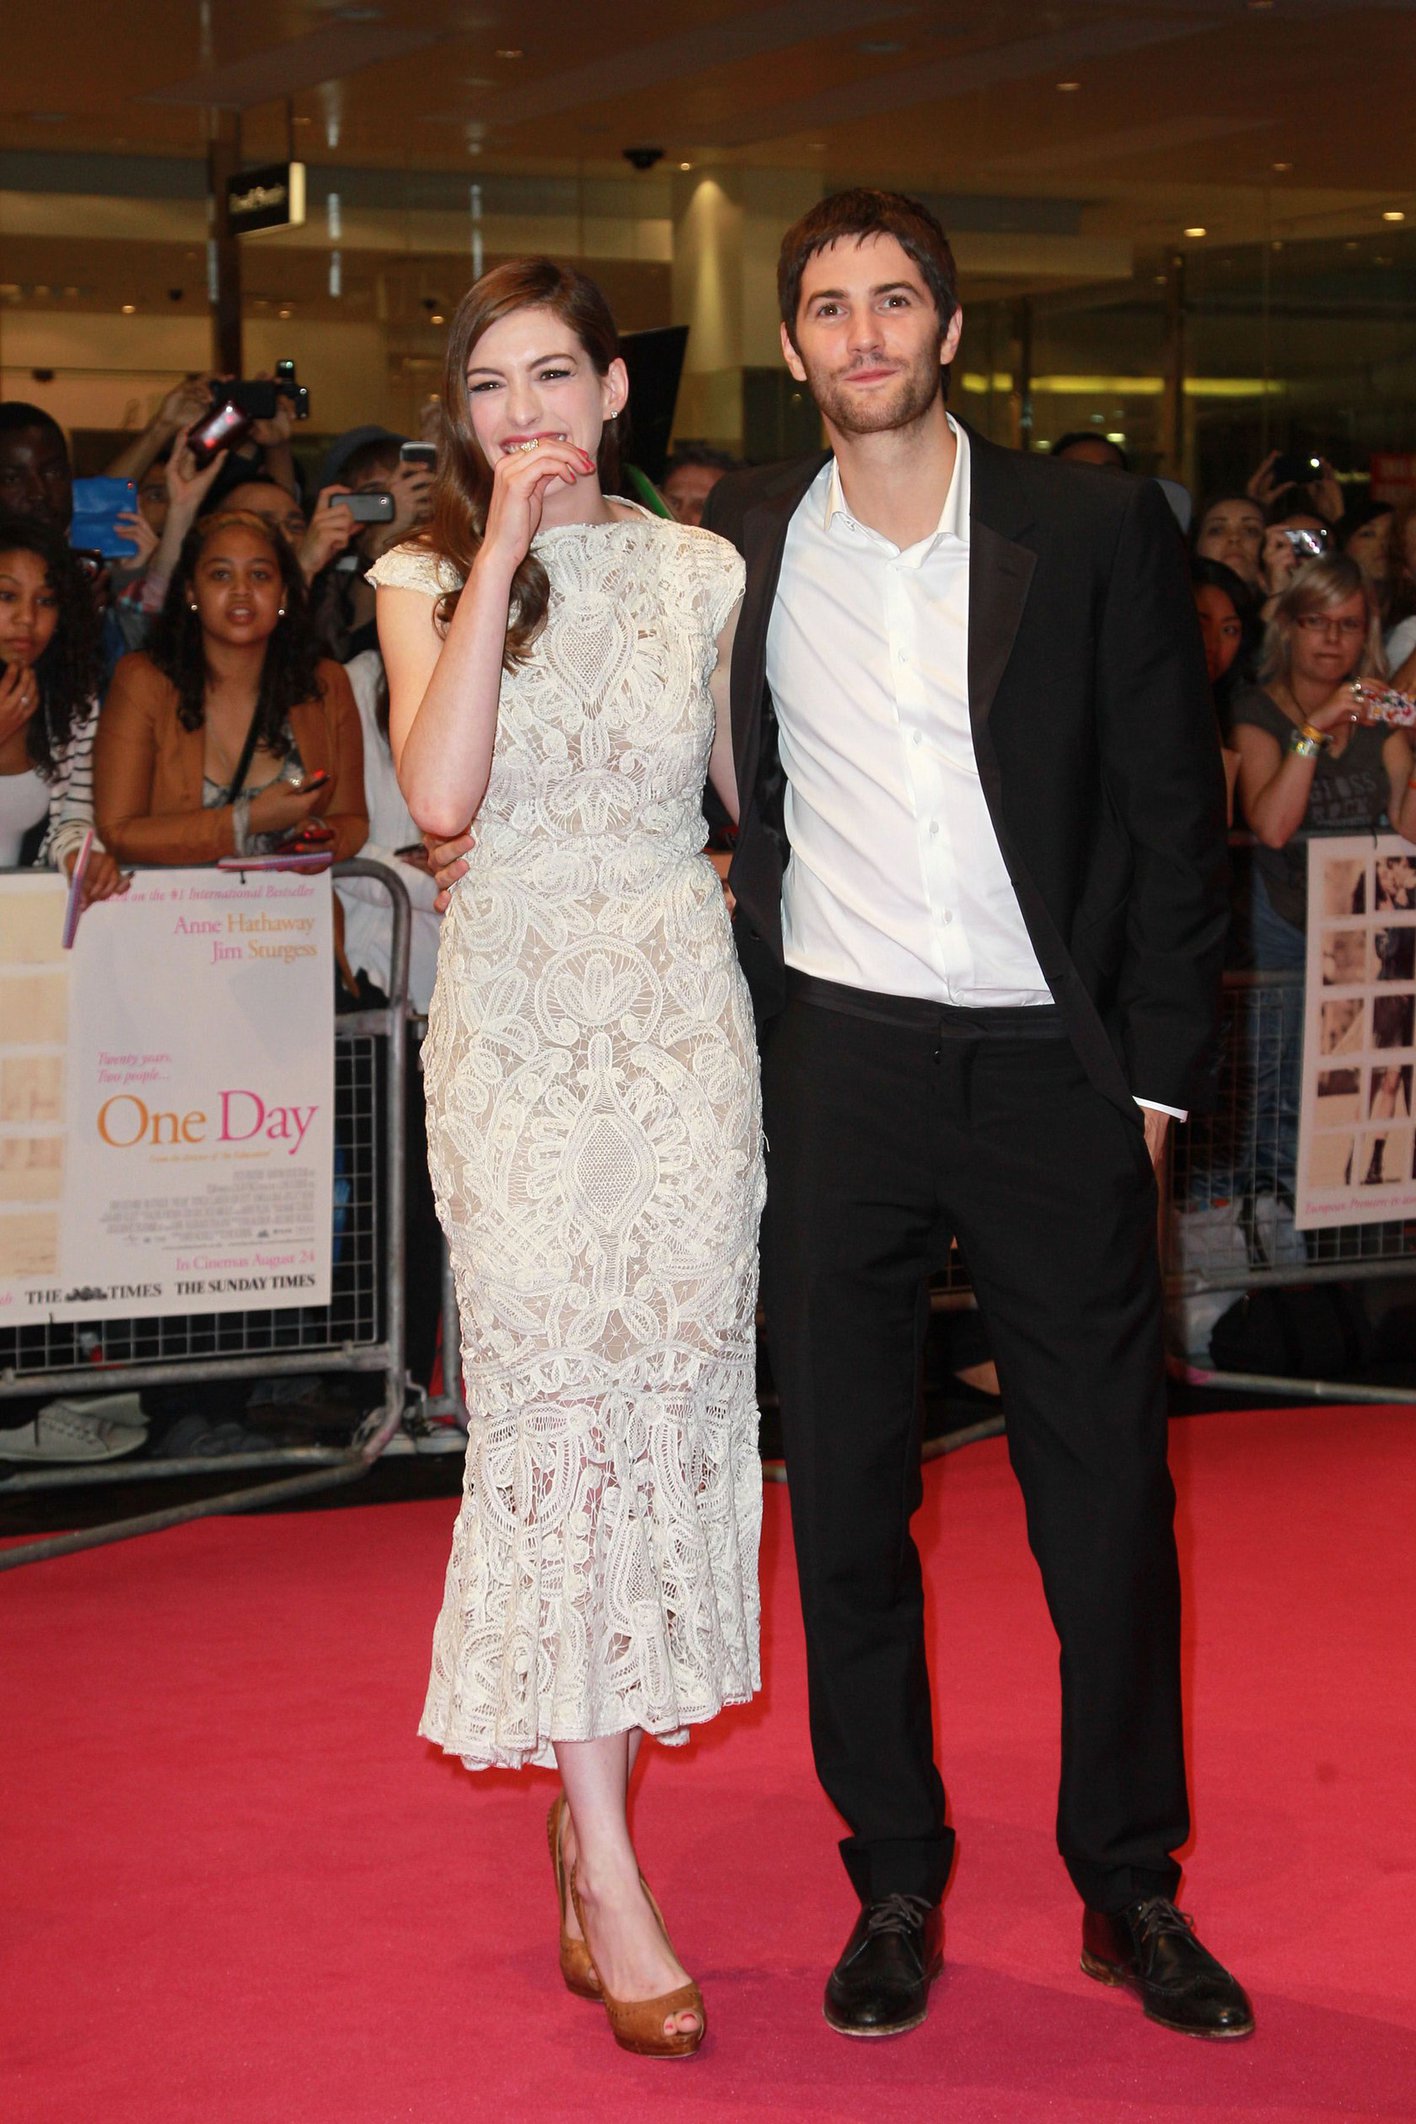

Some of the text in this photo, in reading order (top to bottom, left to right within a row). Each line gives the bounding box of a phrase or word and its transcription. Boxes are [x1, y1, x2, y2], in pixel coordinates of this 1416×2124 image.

[131, 891, 145, 901] on
[149, 888, 165, 900] the
[170, 887, 185, 900] #1
[188, 885, 263, 900] International
[266, 884, 316, 898] Bestseller
[174, 912, 316, 936] Anne Hathaway
[211, 940, 318, 964] Jim Sturgess
[97, 1051, 137, 1066] Twenty
[96, 1089, 320, 1156] One Day
[175, 1249, 316, 1271] In Cinemas August 24
[24, 1289, 62, 1305] THE
[106, 1283, 163, 1300] TIMES
[174, 1273, 316, 1296] THE SUNDAY TIMES
